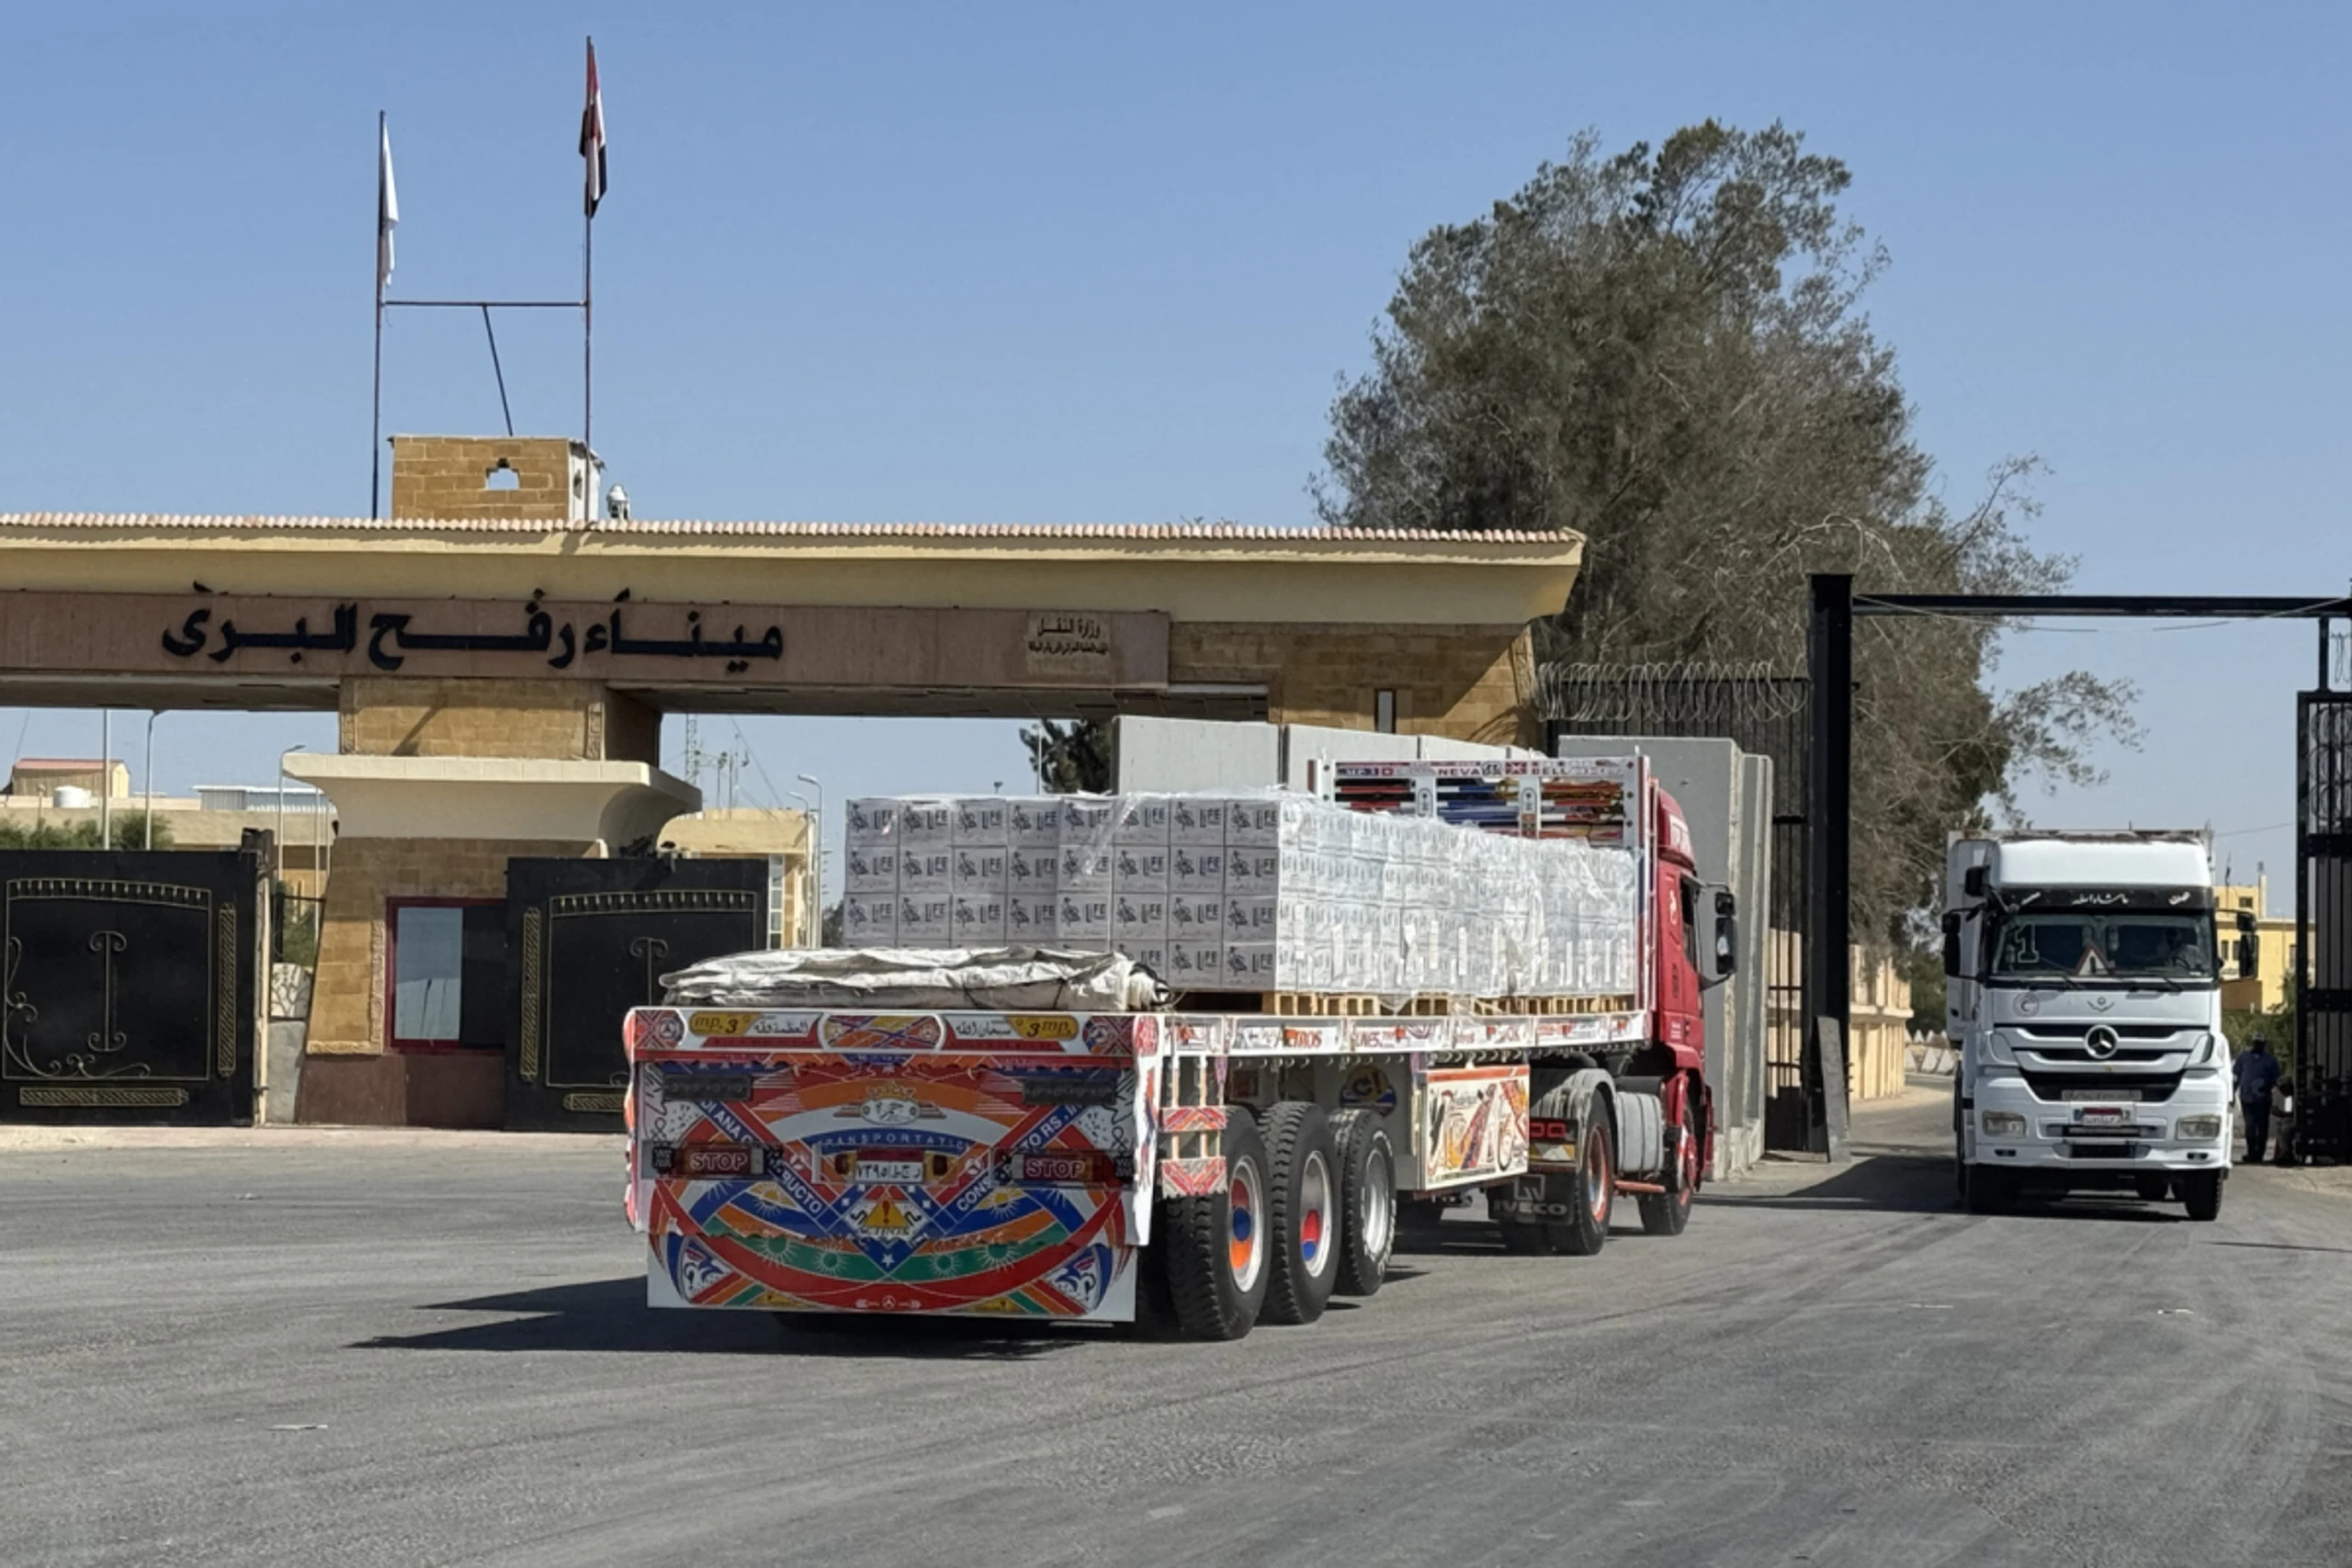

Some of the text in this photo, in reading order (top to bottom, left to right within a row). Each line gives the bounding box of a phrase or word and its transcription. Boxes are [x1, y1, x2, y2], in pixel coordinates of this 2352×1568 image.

[368, 602, 575, 671] رفح
[584, 606, 783, 673] ميناء
[874, 809, 895, 829] LIF
[725, 1019, 739, 1034] 3
[1026, 1022, 1041, 1038] 3
[689, 1151, 749, 1171] STOP
[1024, 1158, 1086, 1179] STOP
[1493, 1201, 1567, 1215] IVECO
